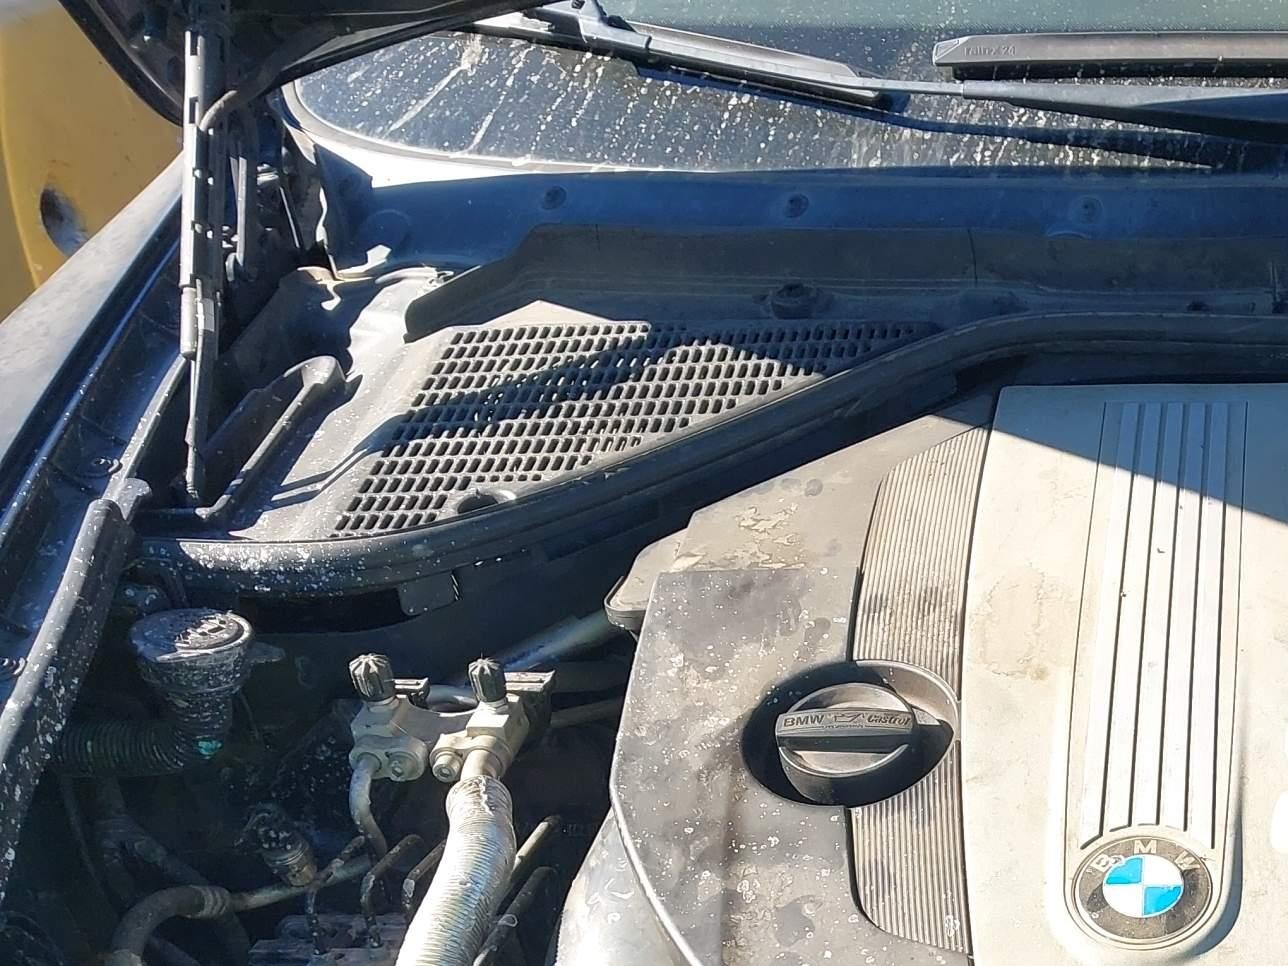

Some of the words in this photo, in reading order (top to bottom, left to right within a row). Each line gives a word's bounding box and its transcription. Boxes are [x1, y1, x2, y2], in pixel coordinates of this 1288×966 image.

[784, 714, 825, 727] BMW
[867, 713, 911, 726] Castrol
[1091, 839, 1201, 873] BMW
